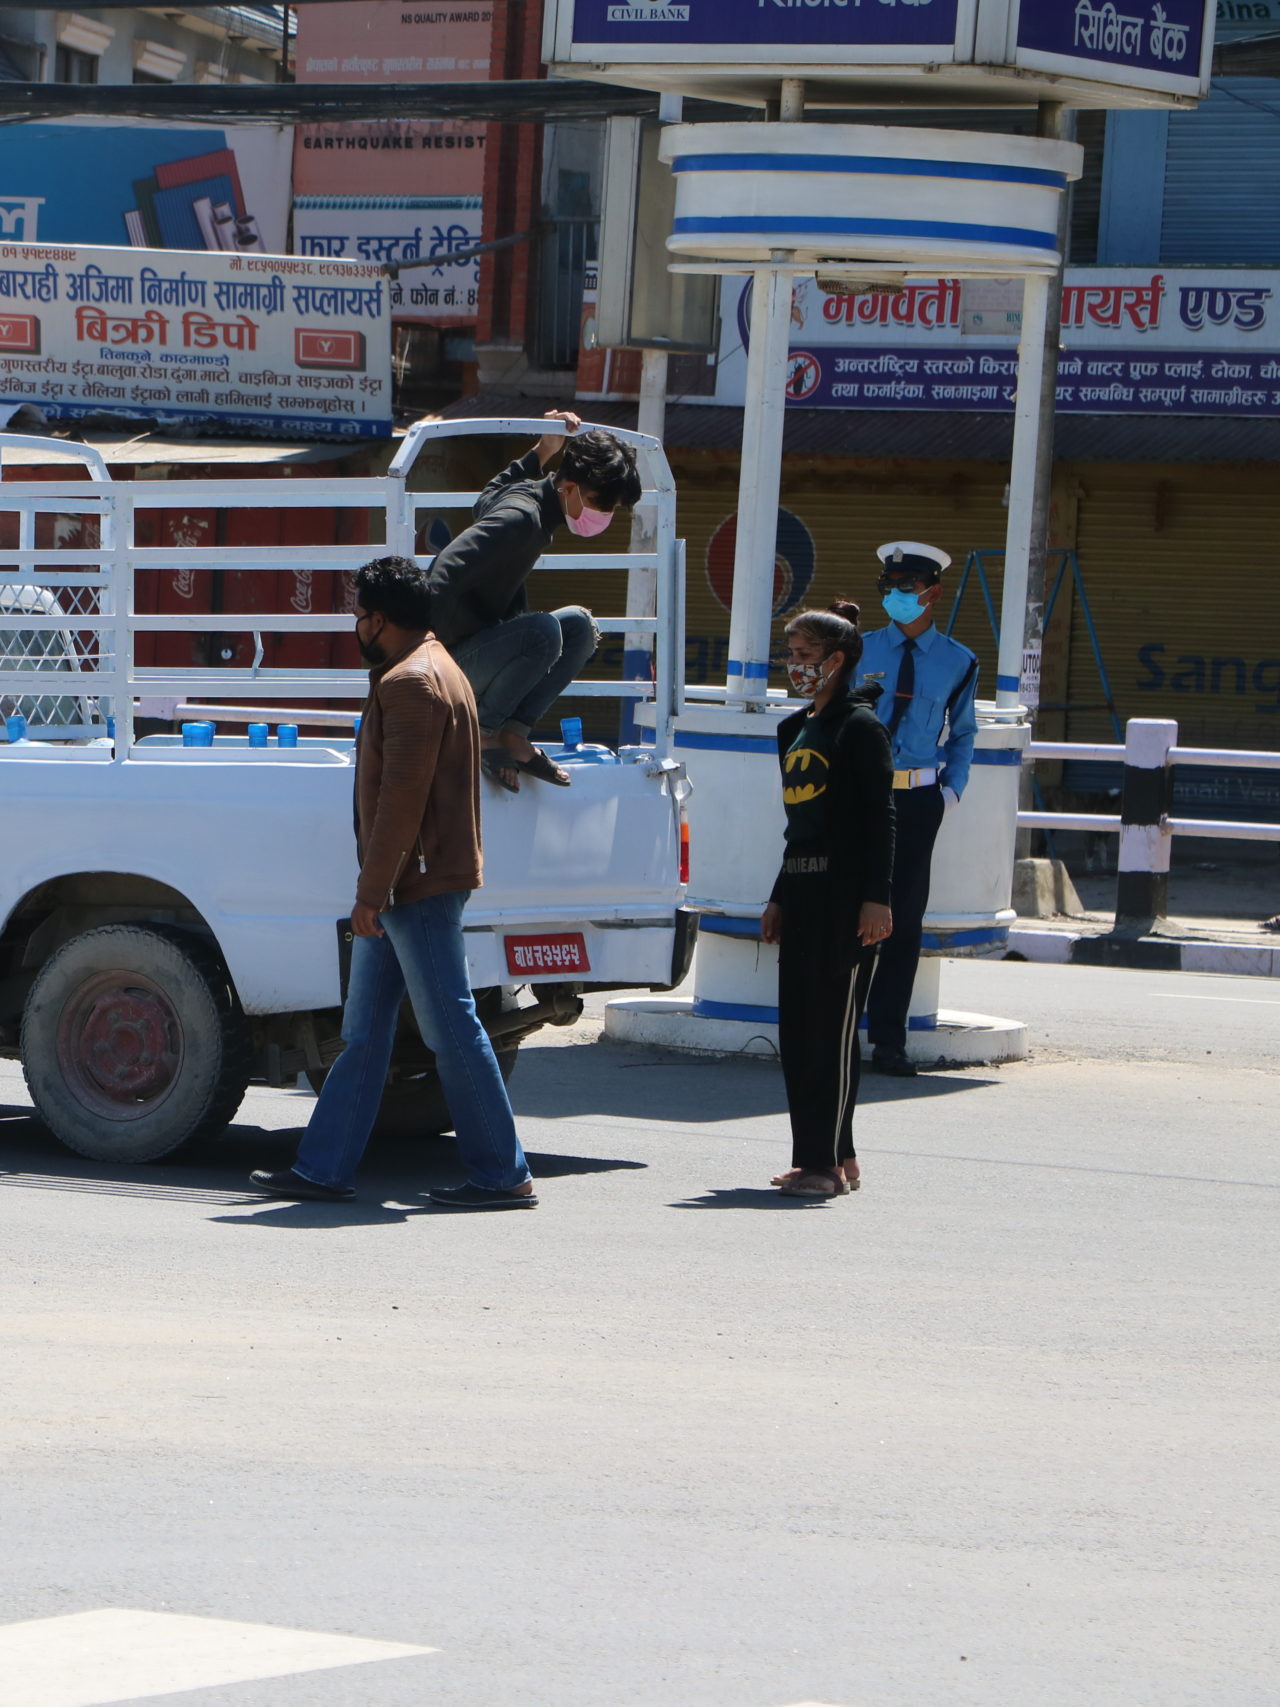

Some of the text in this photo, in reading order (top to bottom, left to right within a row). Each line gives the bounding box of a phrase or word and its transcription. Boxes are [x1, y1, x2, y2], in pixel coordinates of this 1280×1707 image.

[414, 13, 447, 24] QUALITY
[448, 12, 480, 23] AWARD
[611, 9, 686, 20] CIVIL BANK
[1074, 0, 1189, 60] सिभिल बैंक
[304, 136, 413, 150] EARTHQUAKE
[65, 264, 133, 304] अजिमा
[140, 267, 207, 308] निर्माण
[213, 275, 286, 315] सामाग्री
[292, 281, 383, 319] सप्लायर्स
[410, 283, 440, 306] फोन
[1179, 287, 1272, 331] एण्ड
[75, 305, 260, 351] बिक्री डिपो
[924, 356, 974, 374] स्तरको
[1087, 362, 1124, 377] वाटर
[67, 384, 77, 396] र
[832, 383, 859, 397] तथा
